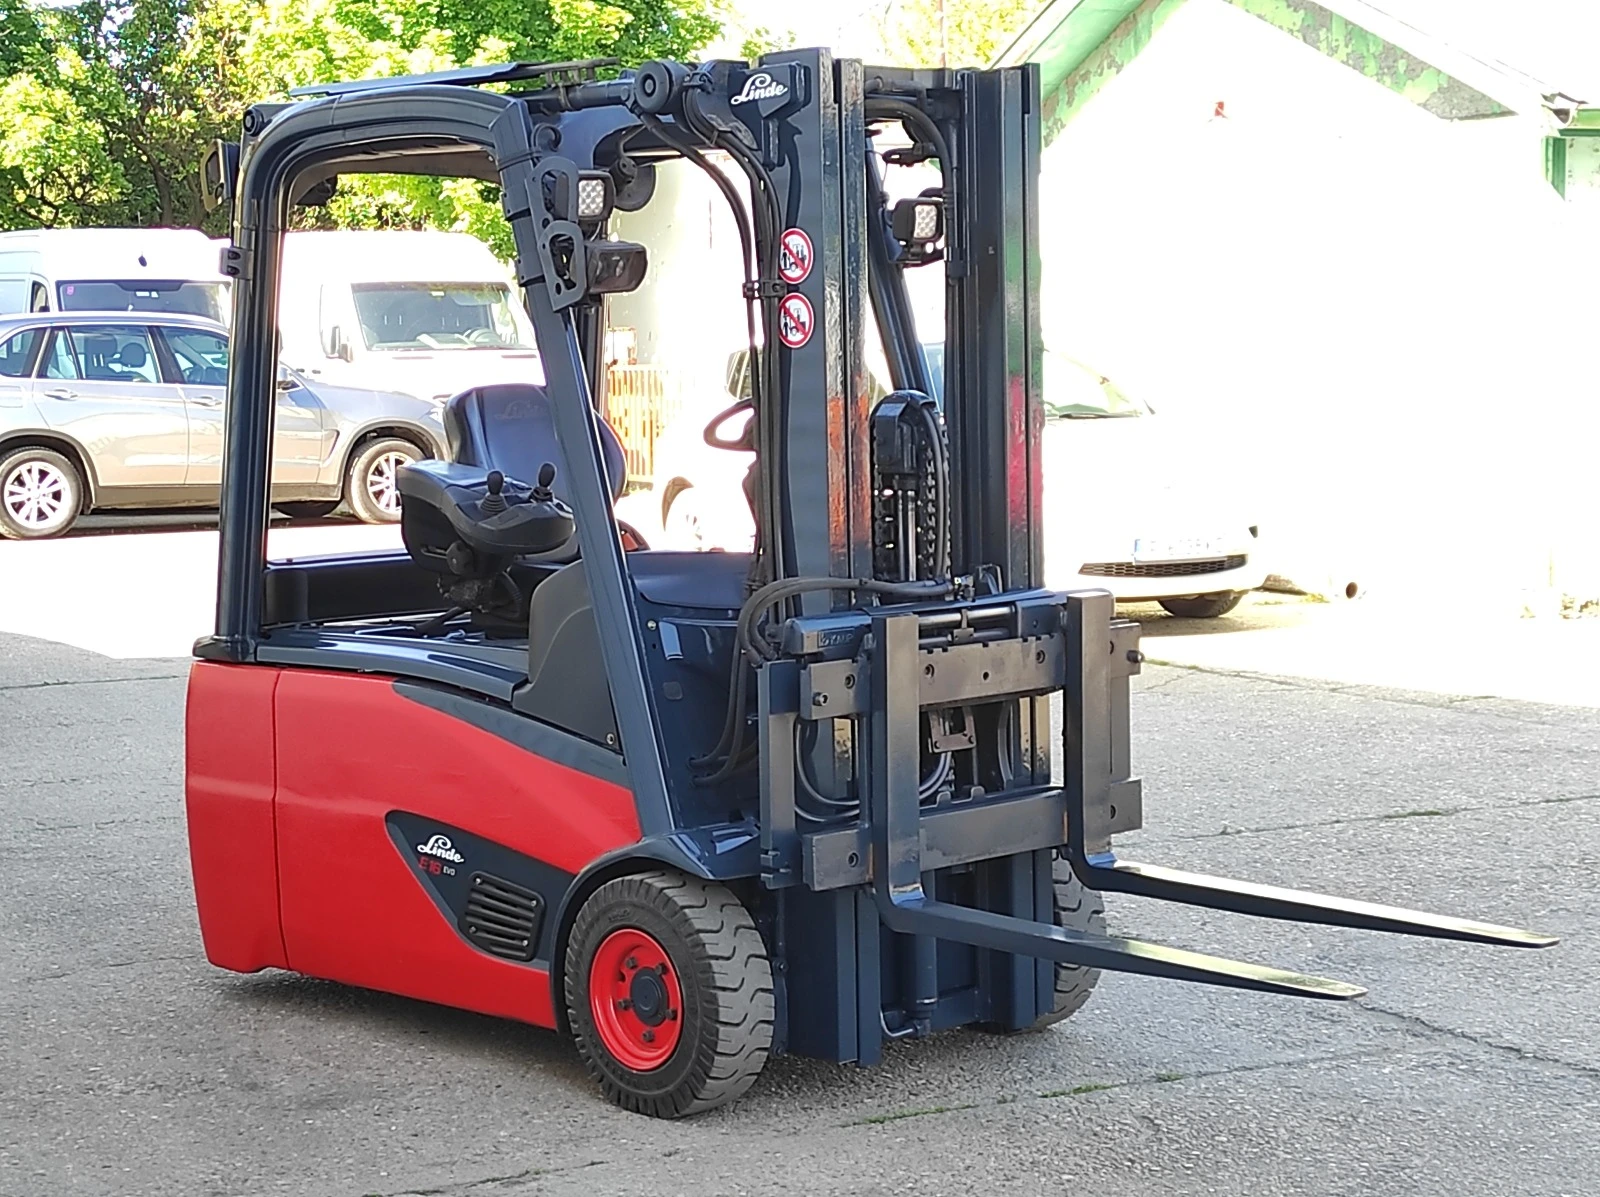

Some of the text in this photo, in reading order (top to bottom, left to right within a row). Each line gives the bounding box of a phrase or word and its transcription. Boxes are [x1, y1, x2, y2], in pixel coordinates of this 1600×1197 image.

[730, 73, 788, 105] Linde
[416, 834, 465, 863] Linde
[442, 865, 456, 876] EVO
